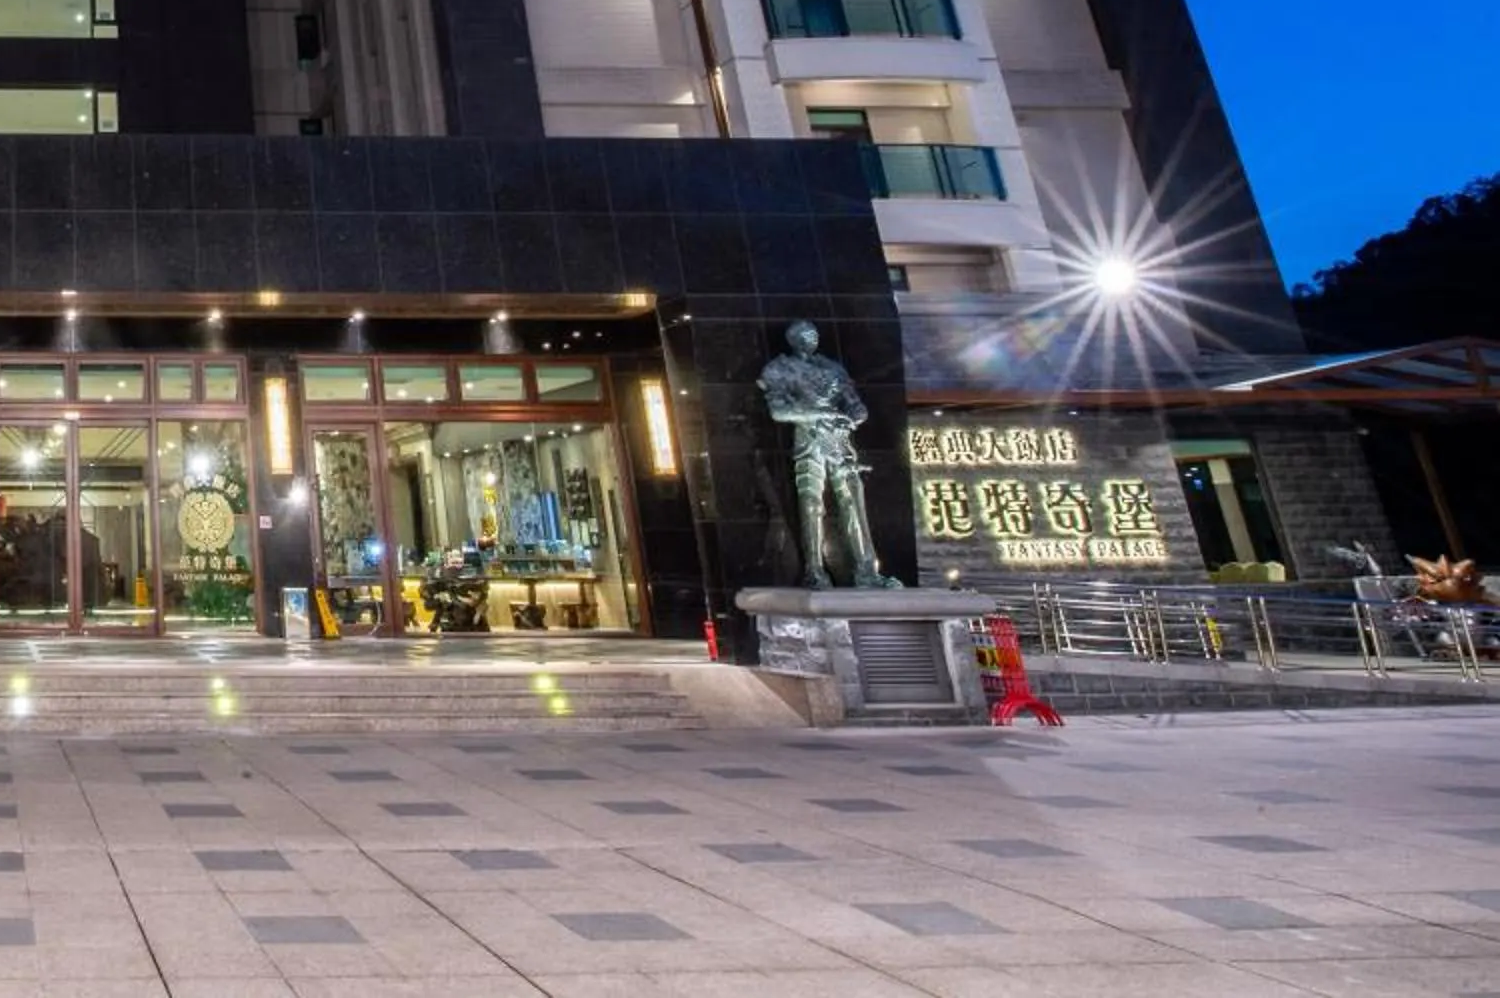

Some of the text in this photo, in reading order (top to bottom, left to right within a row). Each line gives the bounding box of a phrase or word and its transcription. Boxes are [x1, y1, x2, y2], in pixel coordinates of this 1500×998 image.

[920, 479, 1163, 536] 范特奇堡
[1096, 538, 1168, 559] PALACE
